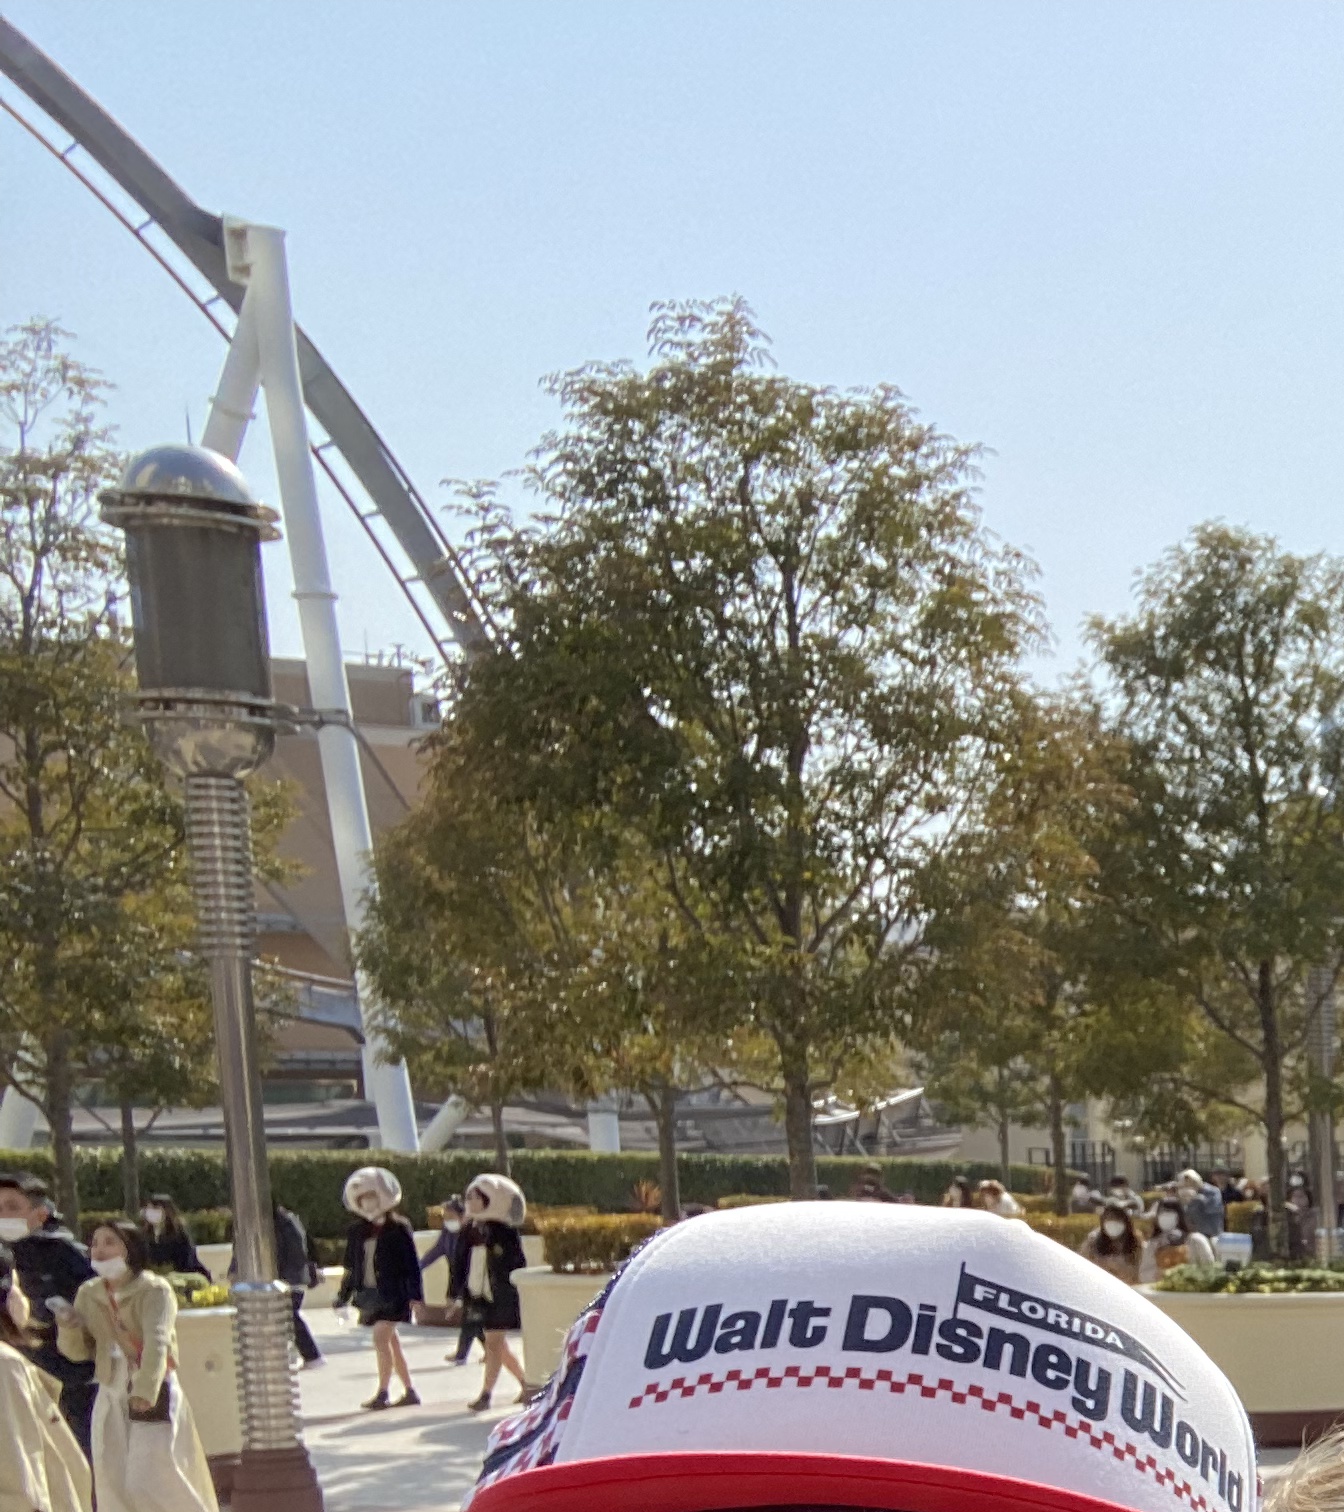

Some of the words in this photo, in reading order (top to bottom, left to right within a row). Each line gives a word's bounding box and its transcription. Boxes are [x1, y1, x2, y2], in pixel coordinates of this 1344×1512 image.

[644, 1299, 832, 1369] Walt
[842, 1294, 1112, 1421] Disney
[973, 1284, 1124, 1349] FLORIDA
